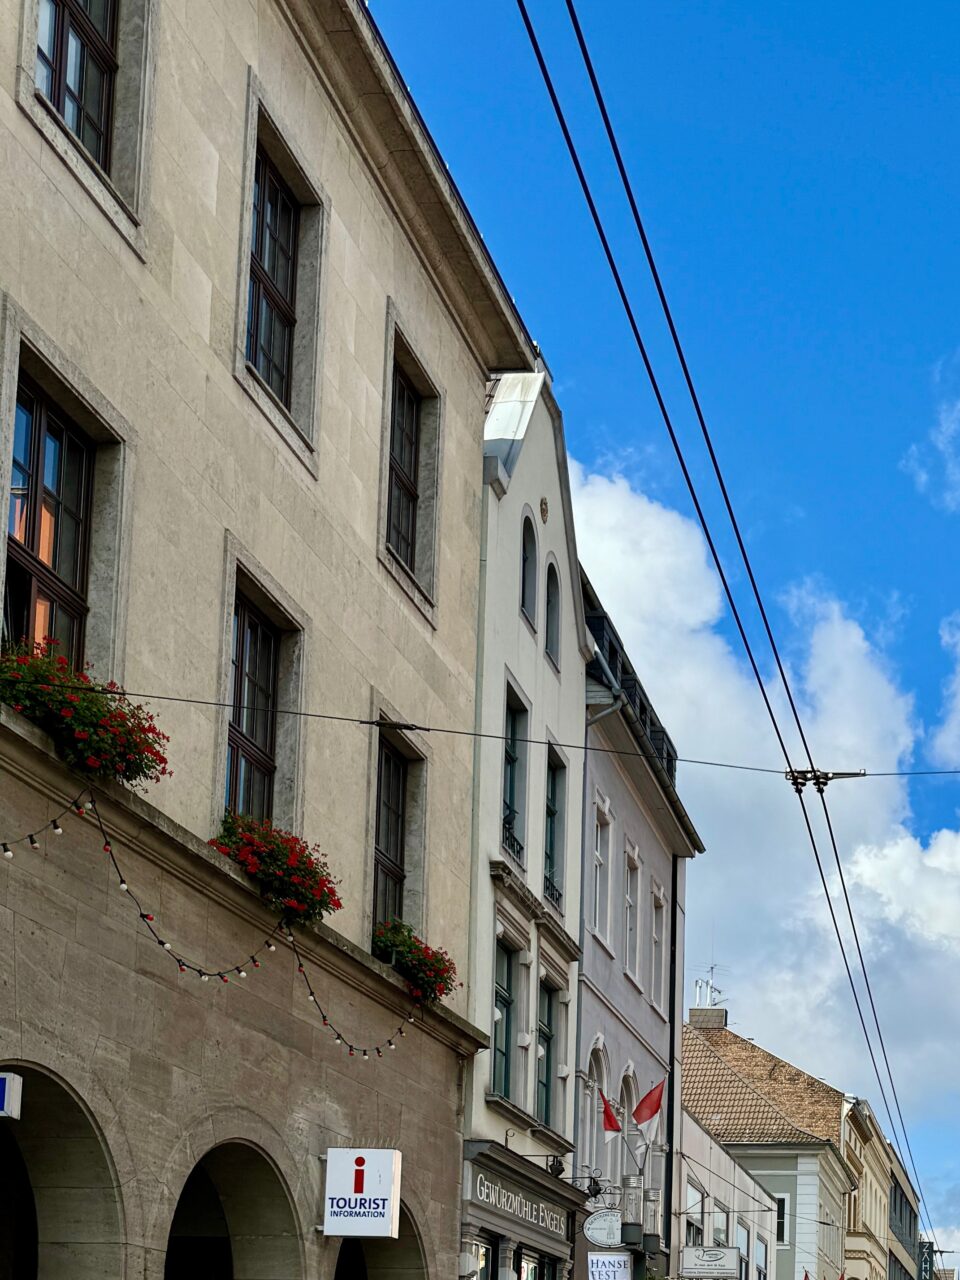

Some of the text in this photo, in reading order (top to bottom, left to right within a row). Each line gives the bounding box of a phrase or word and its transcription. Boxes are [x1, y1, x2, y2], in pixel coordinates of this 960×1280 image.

[328, 1197, 388, 1210] TOURIST
[476, 1173, 565, 1236] GEWÜRZMÜHLE ENGELS
[330, 1210, 385, 1218] INFORMATION
[591, 1259, 629, 1269] HANSE
[591, 1270, 620, 1280] FEST
